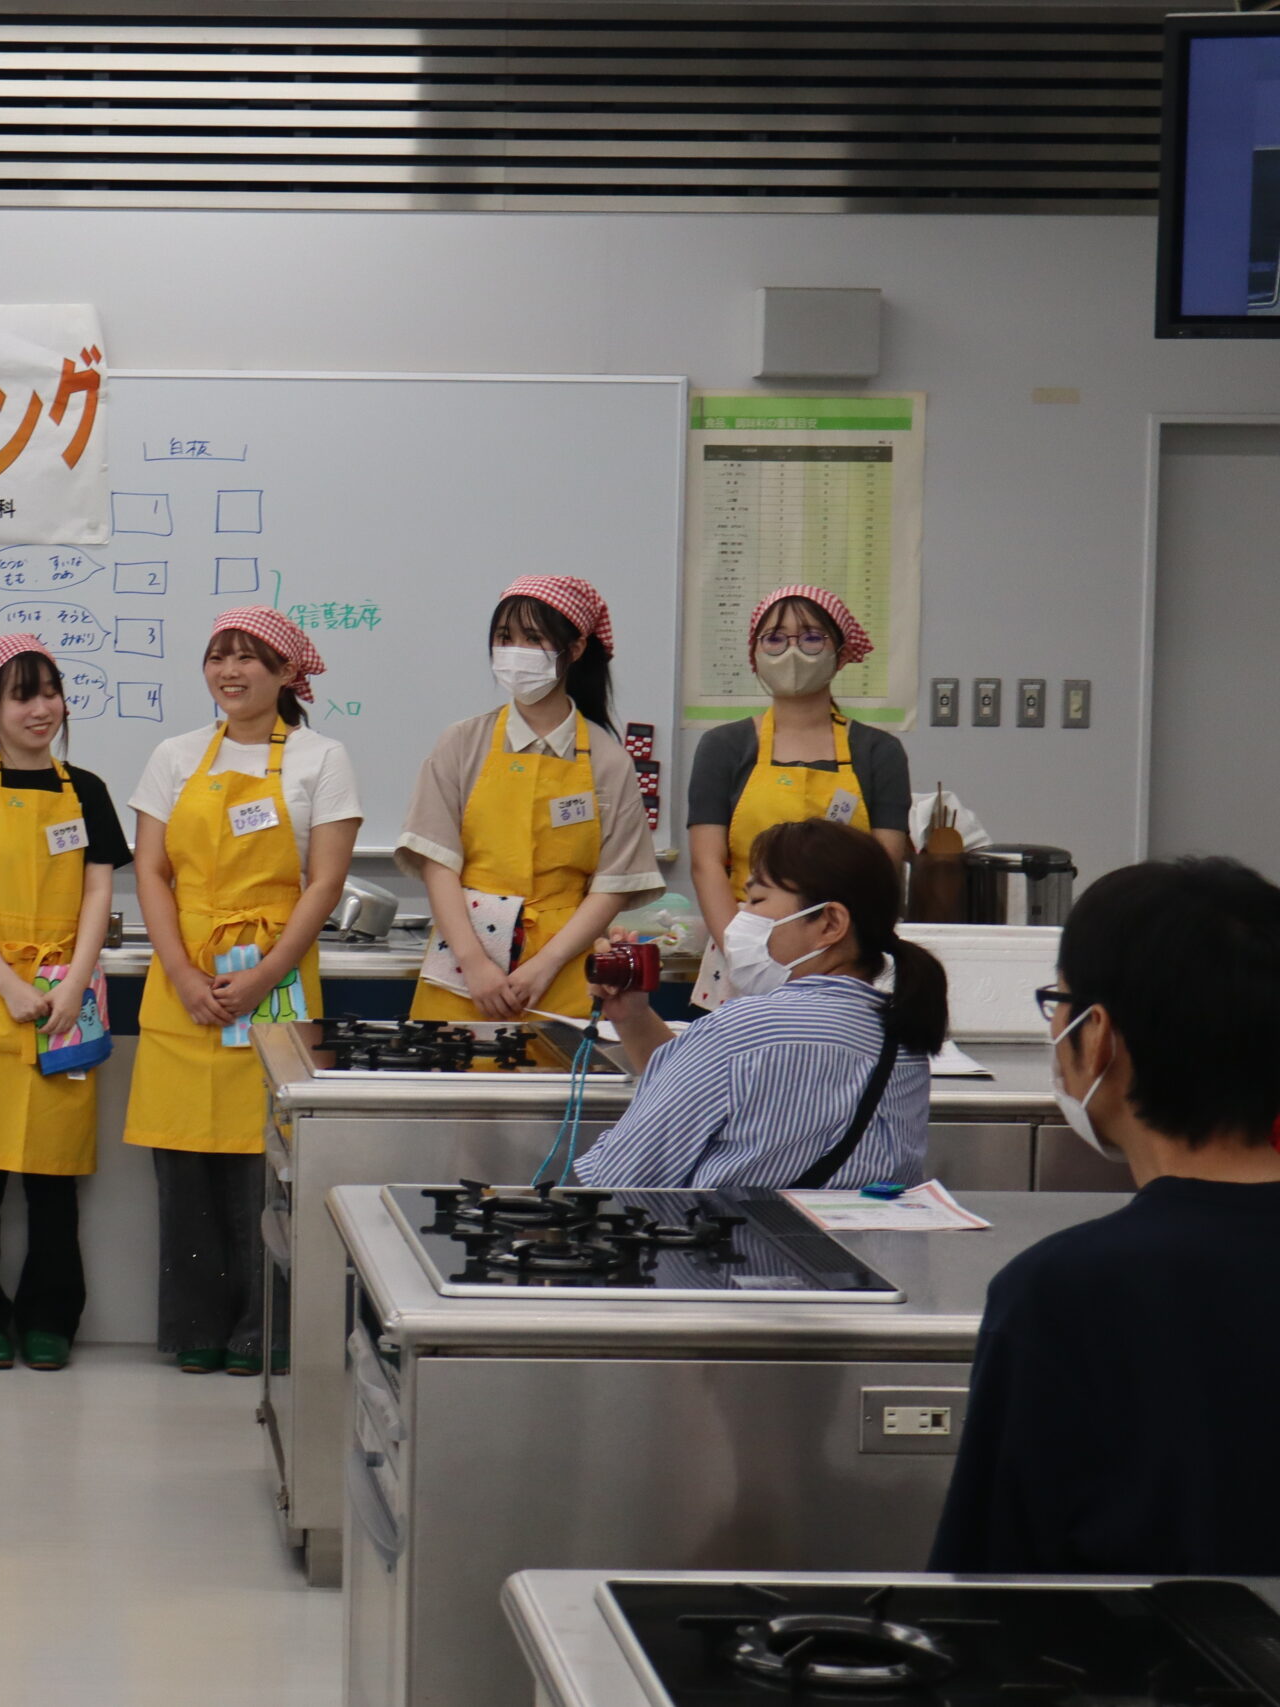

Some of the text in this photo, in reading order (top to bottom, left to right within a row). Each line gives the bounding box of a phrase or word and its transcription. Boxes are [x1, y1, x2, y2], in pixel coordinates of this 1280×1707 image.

[148, 573, 160, 586] 2
[147, 626, 157, 645] 3
[147, 690, 158, 706] 4
